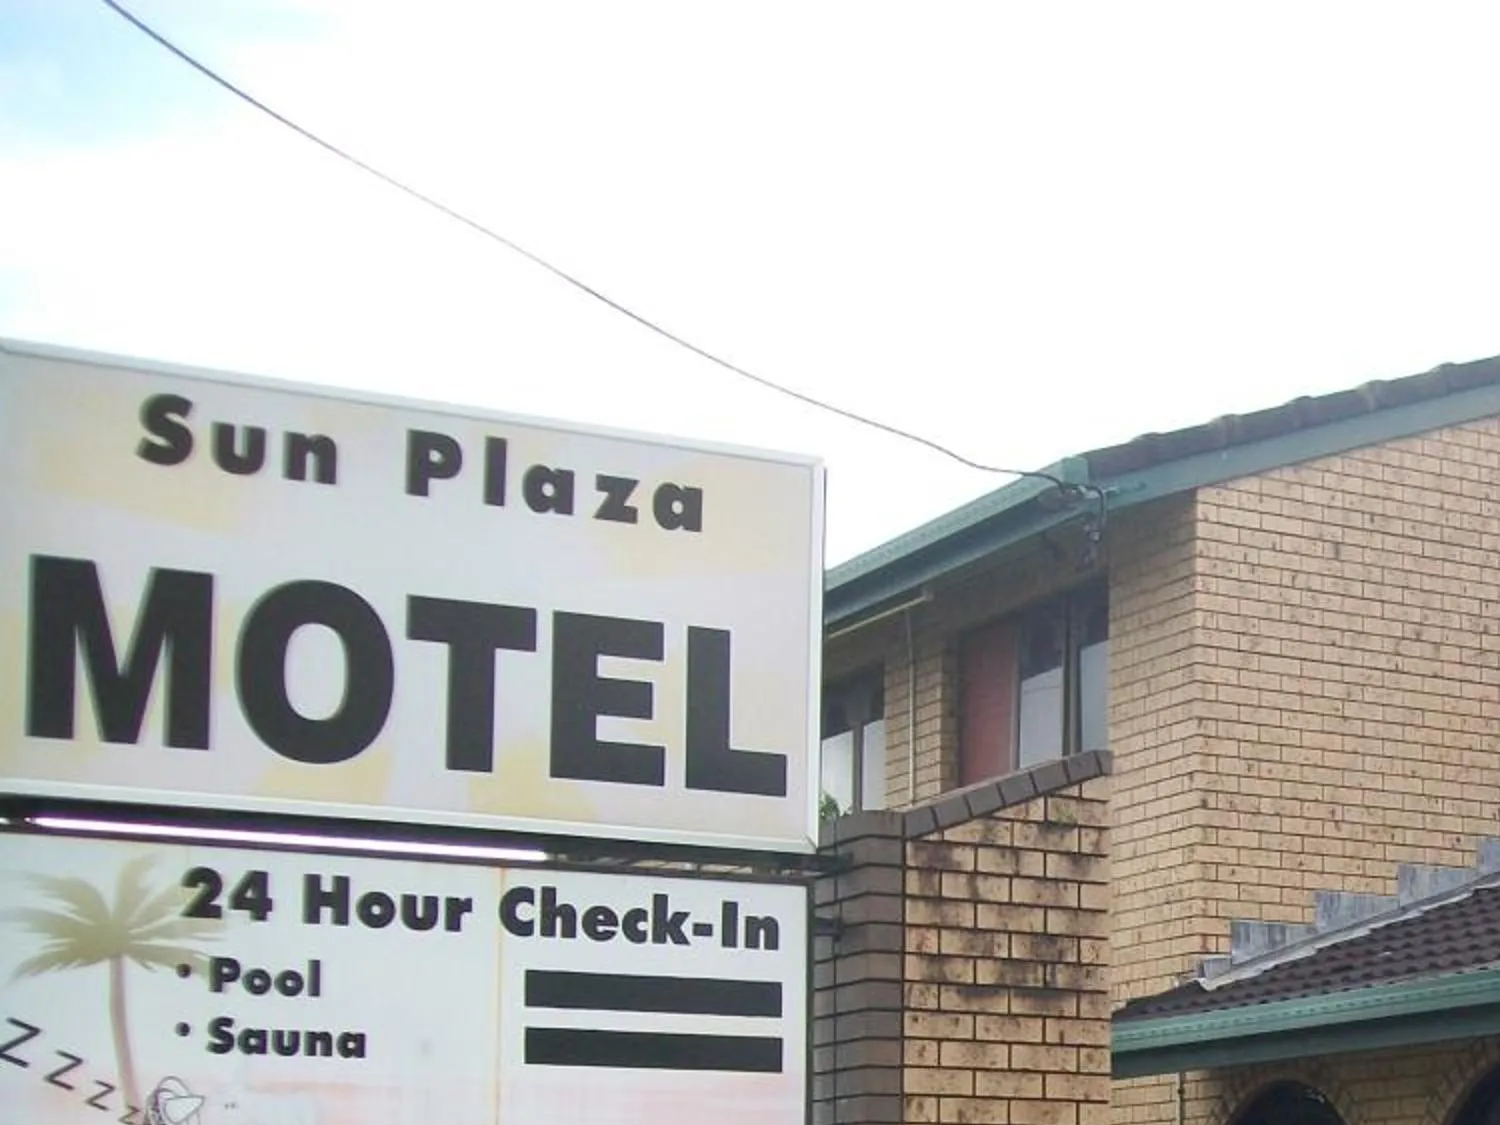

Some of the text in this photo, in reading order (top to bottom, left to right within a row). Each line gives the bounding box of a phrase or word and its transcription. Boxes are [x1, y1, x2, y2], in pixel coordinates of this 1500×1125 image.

[137, 393, 704, 532] Sun Plaza
[25, 553, 788, 798] MOTEL
[180, 865, 780, 951] 24 Hour Check-In
[209, 957, 322, 997] Pool
[205, 1016, 367, 1058] Sauna
